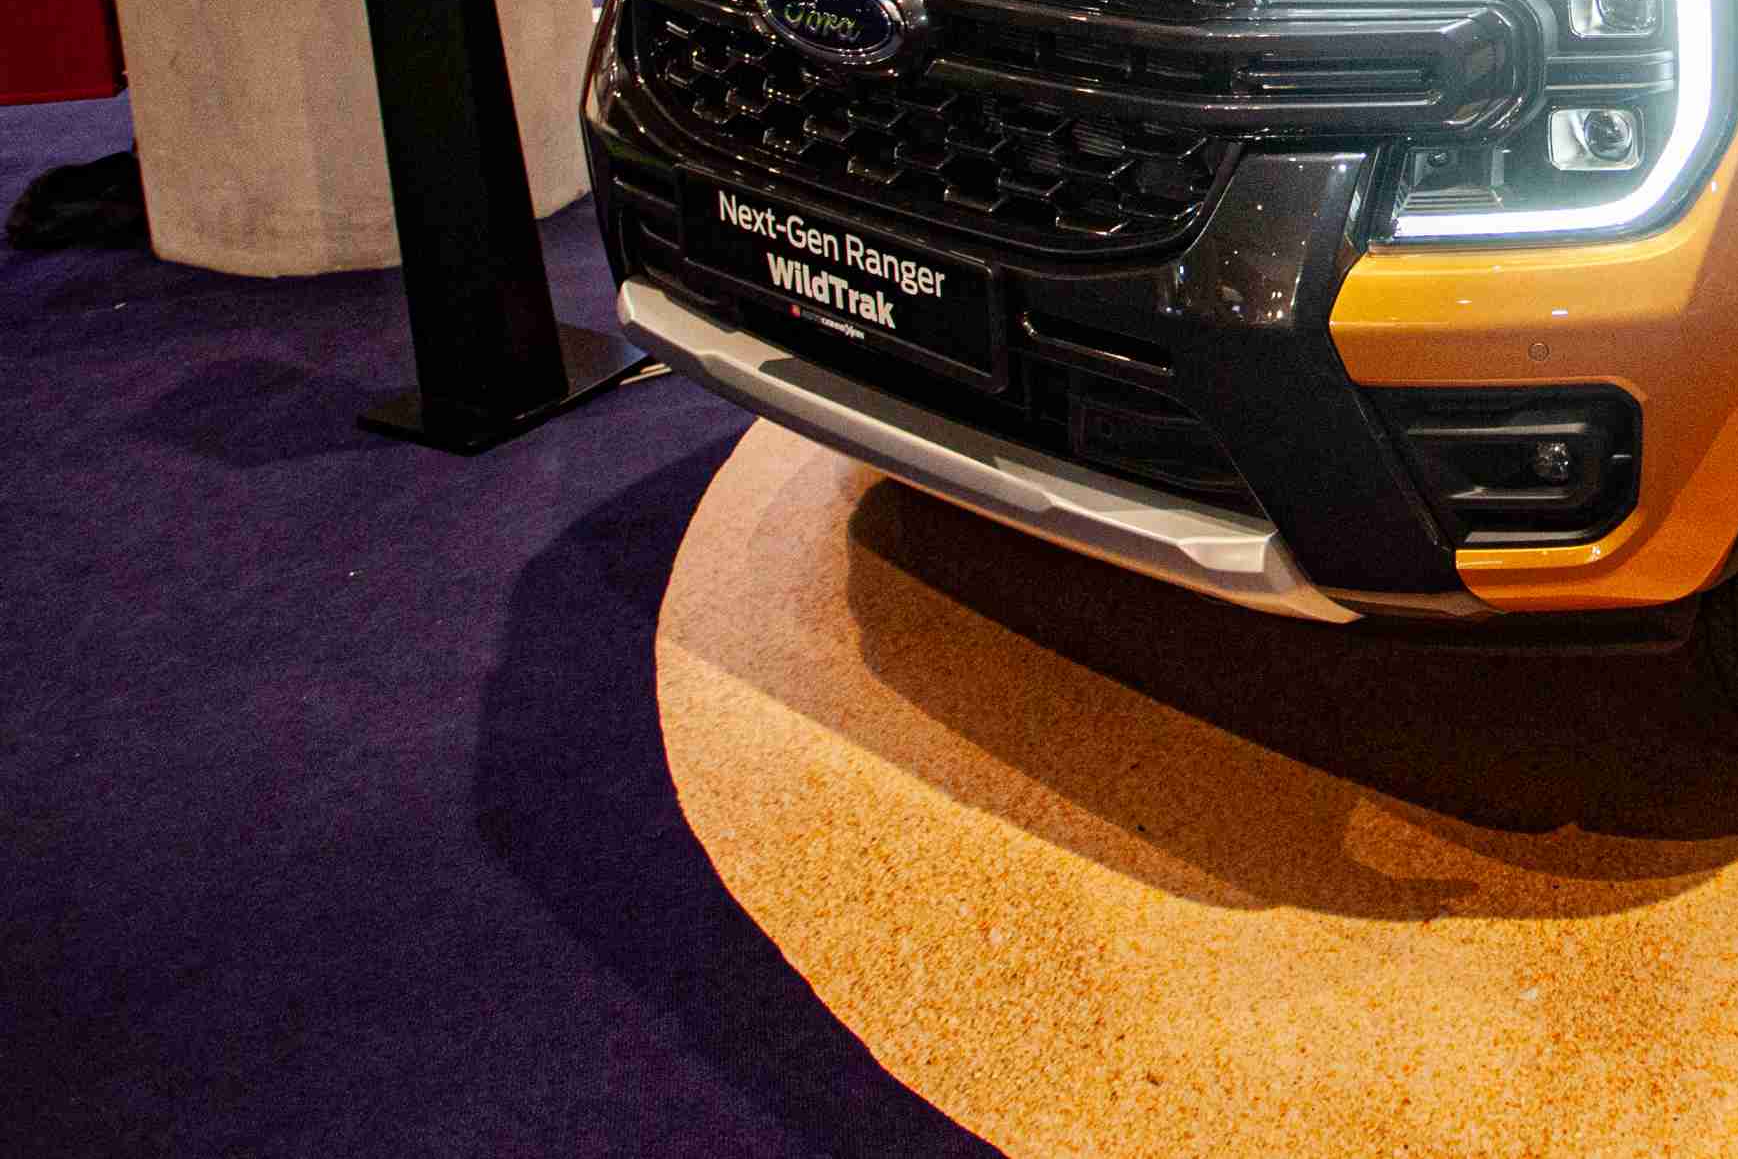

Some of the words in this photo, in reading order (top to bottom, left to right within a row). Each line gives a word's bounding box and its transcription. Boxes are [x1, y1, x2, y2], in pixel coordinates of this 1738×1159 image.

[717, 190, 840, 262] Next-Gen
[845, 233, 946, 298] Ranger
[766, 252, 897, 330] WildTrak
